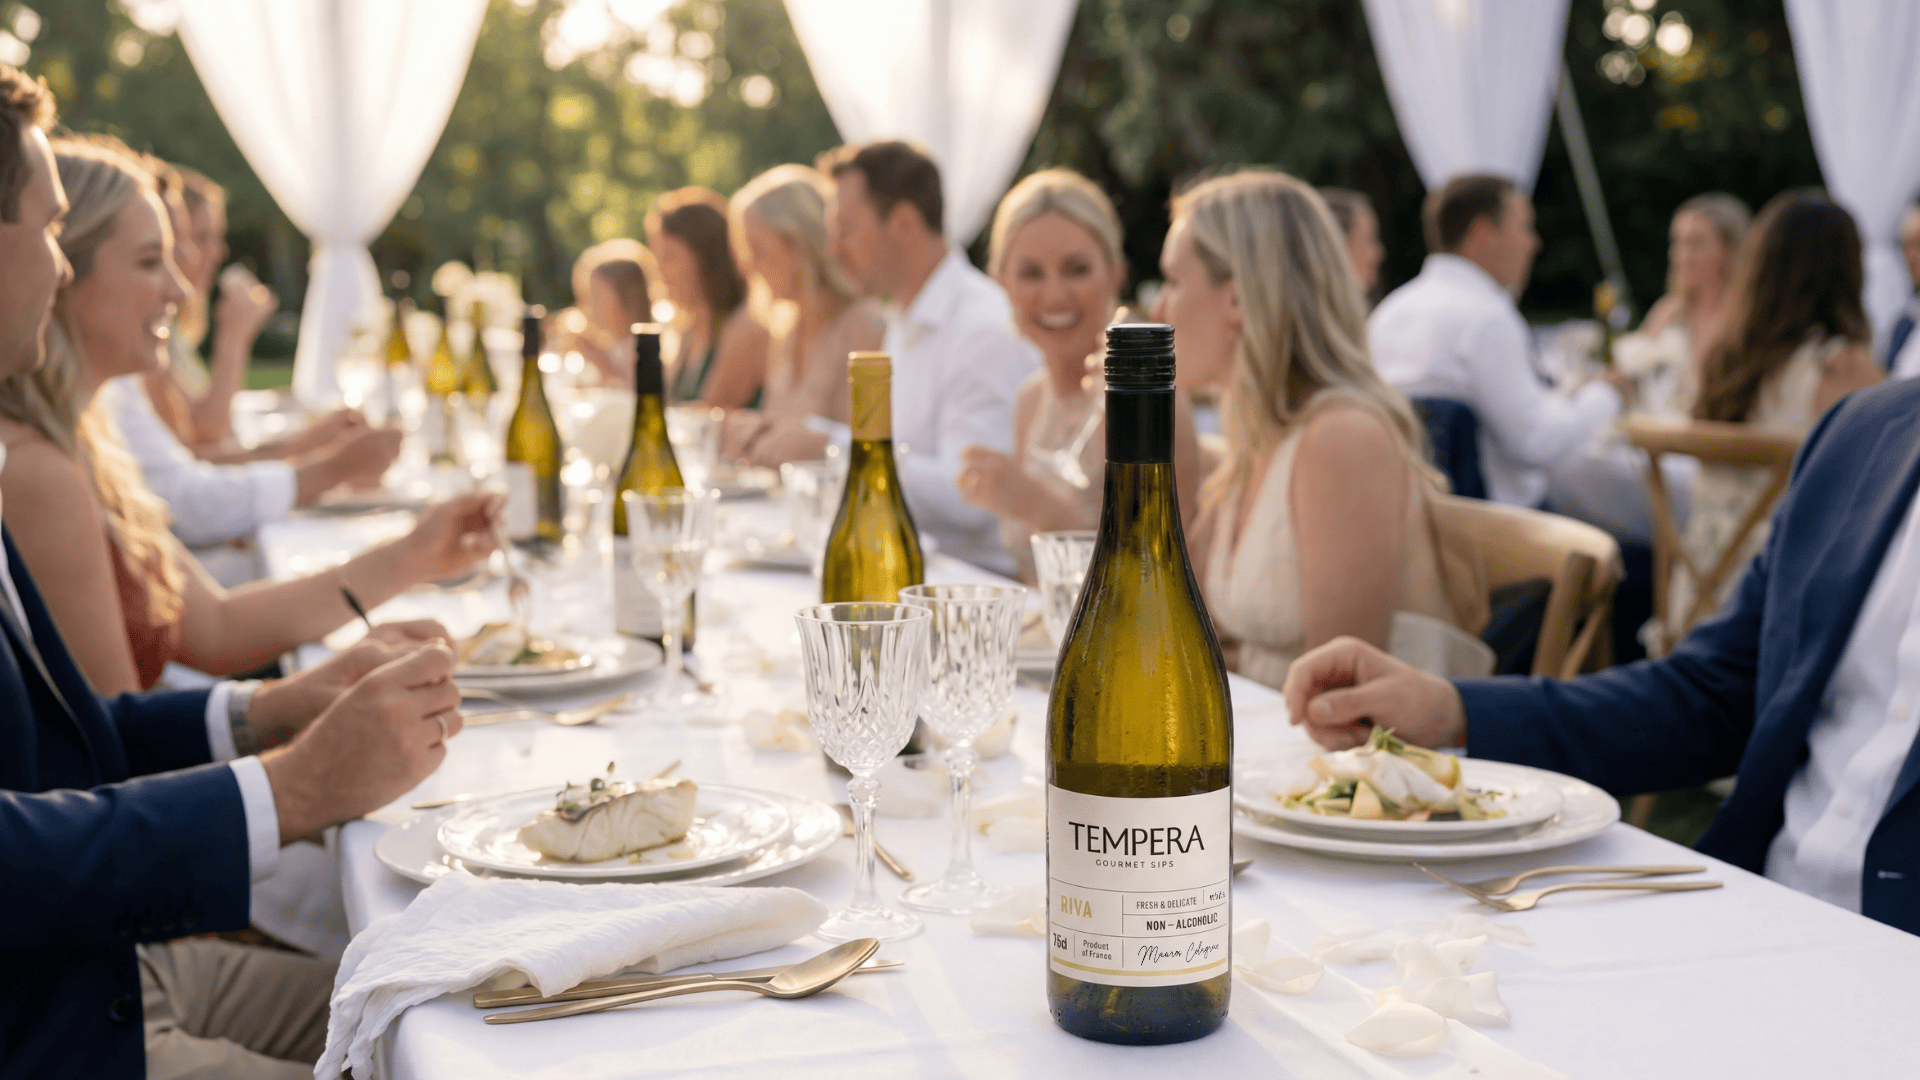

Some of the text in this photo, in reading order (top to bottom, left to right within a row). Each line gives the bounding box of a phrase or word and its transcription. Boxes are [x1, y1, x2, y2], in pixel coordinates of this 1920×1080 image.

[1069, 821, 1204, 856] TEMPERA
[1096, 859, 1174, 869] GOURMET SIPS
[1061, 895, 1092, 918] RIVA
[1136, 897, 1197, 910] FRESH & DELICATE
[1146, 921, 1166, 931] NON
[1176, 912, 1218, 930] ALCOHOLIC
[1082, 949, 1112, 960] of France
